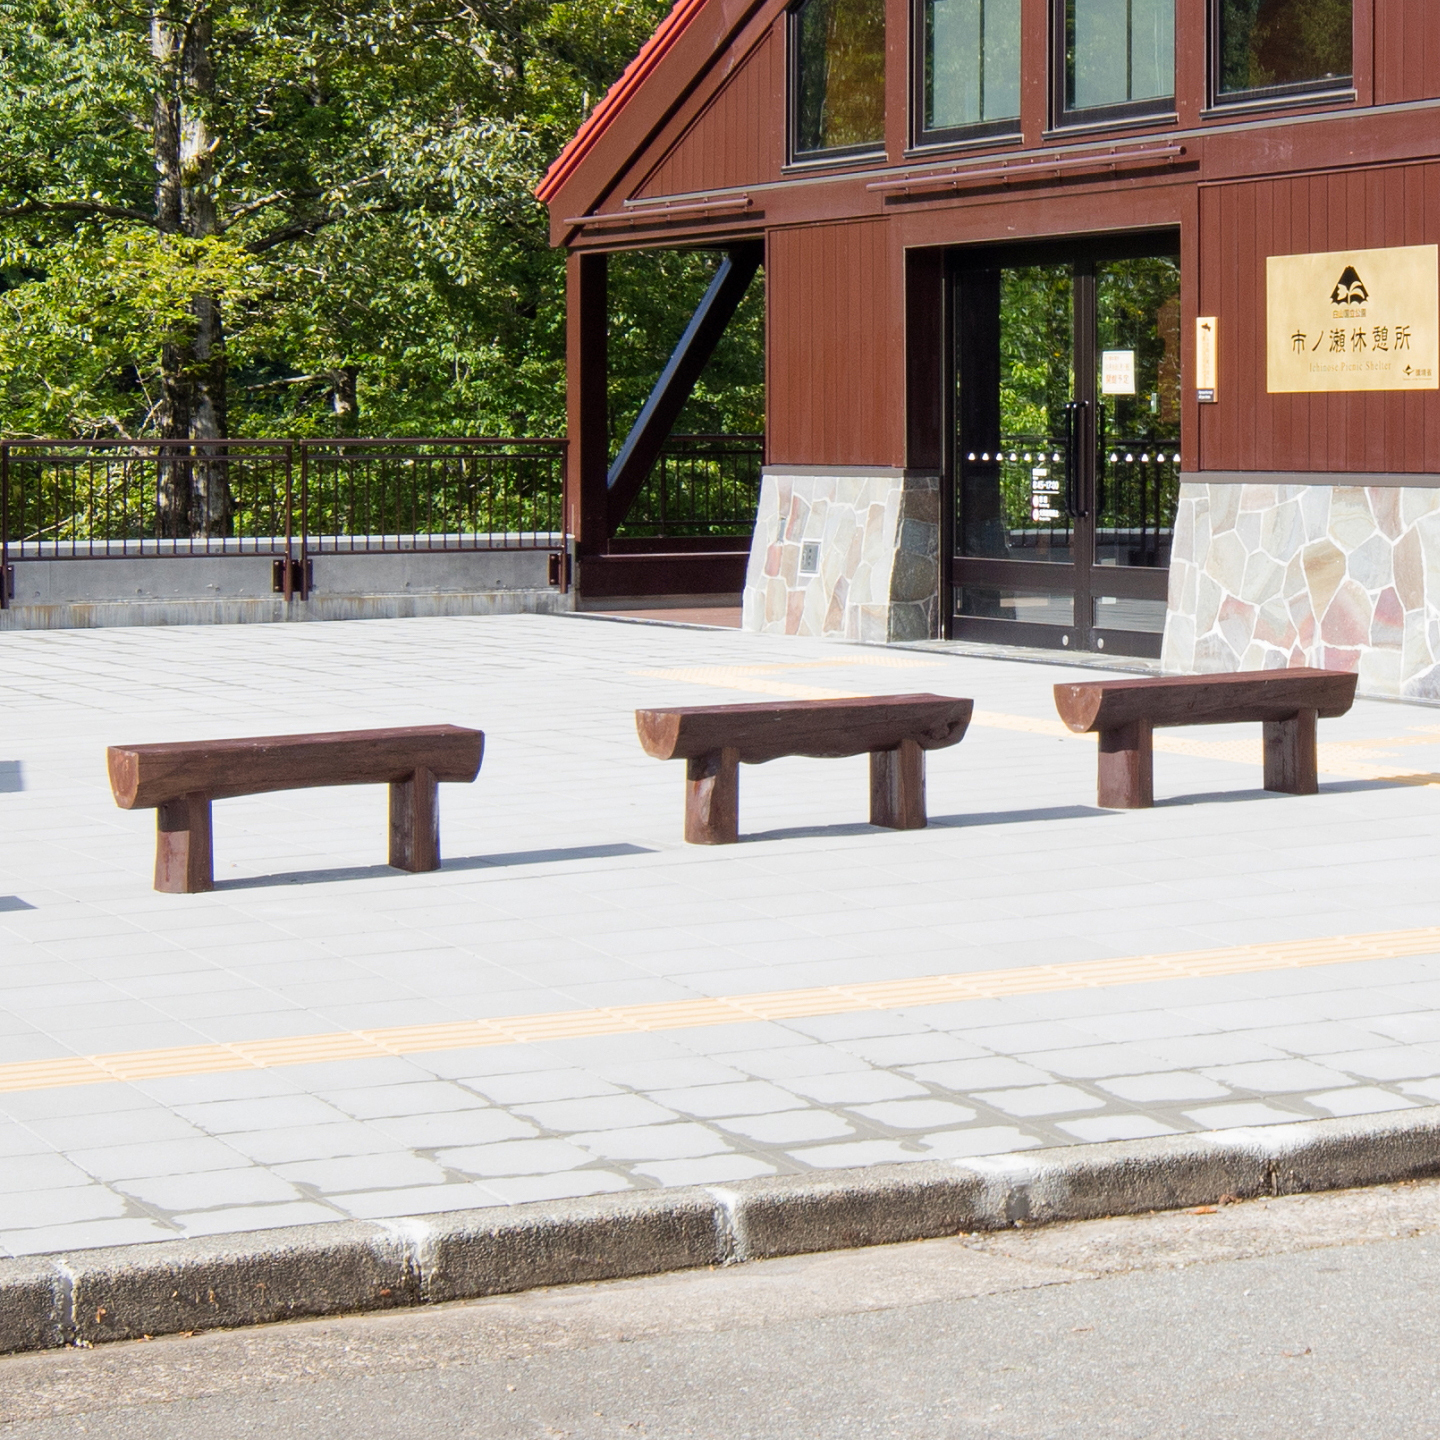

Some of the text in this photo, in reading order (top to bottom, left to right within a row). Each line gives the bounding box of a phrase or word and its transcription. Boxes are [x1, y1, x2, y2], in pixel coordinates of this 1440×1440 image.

[1332, 308, 1367, 319] 白山国立公園
[1290, 325, 1412, 355] 市ノ瀬休憩所
[1309, 360, 1391, 372] Ichinose Picnic Shelter
